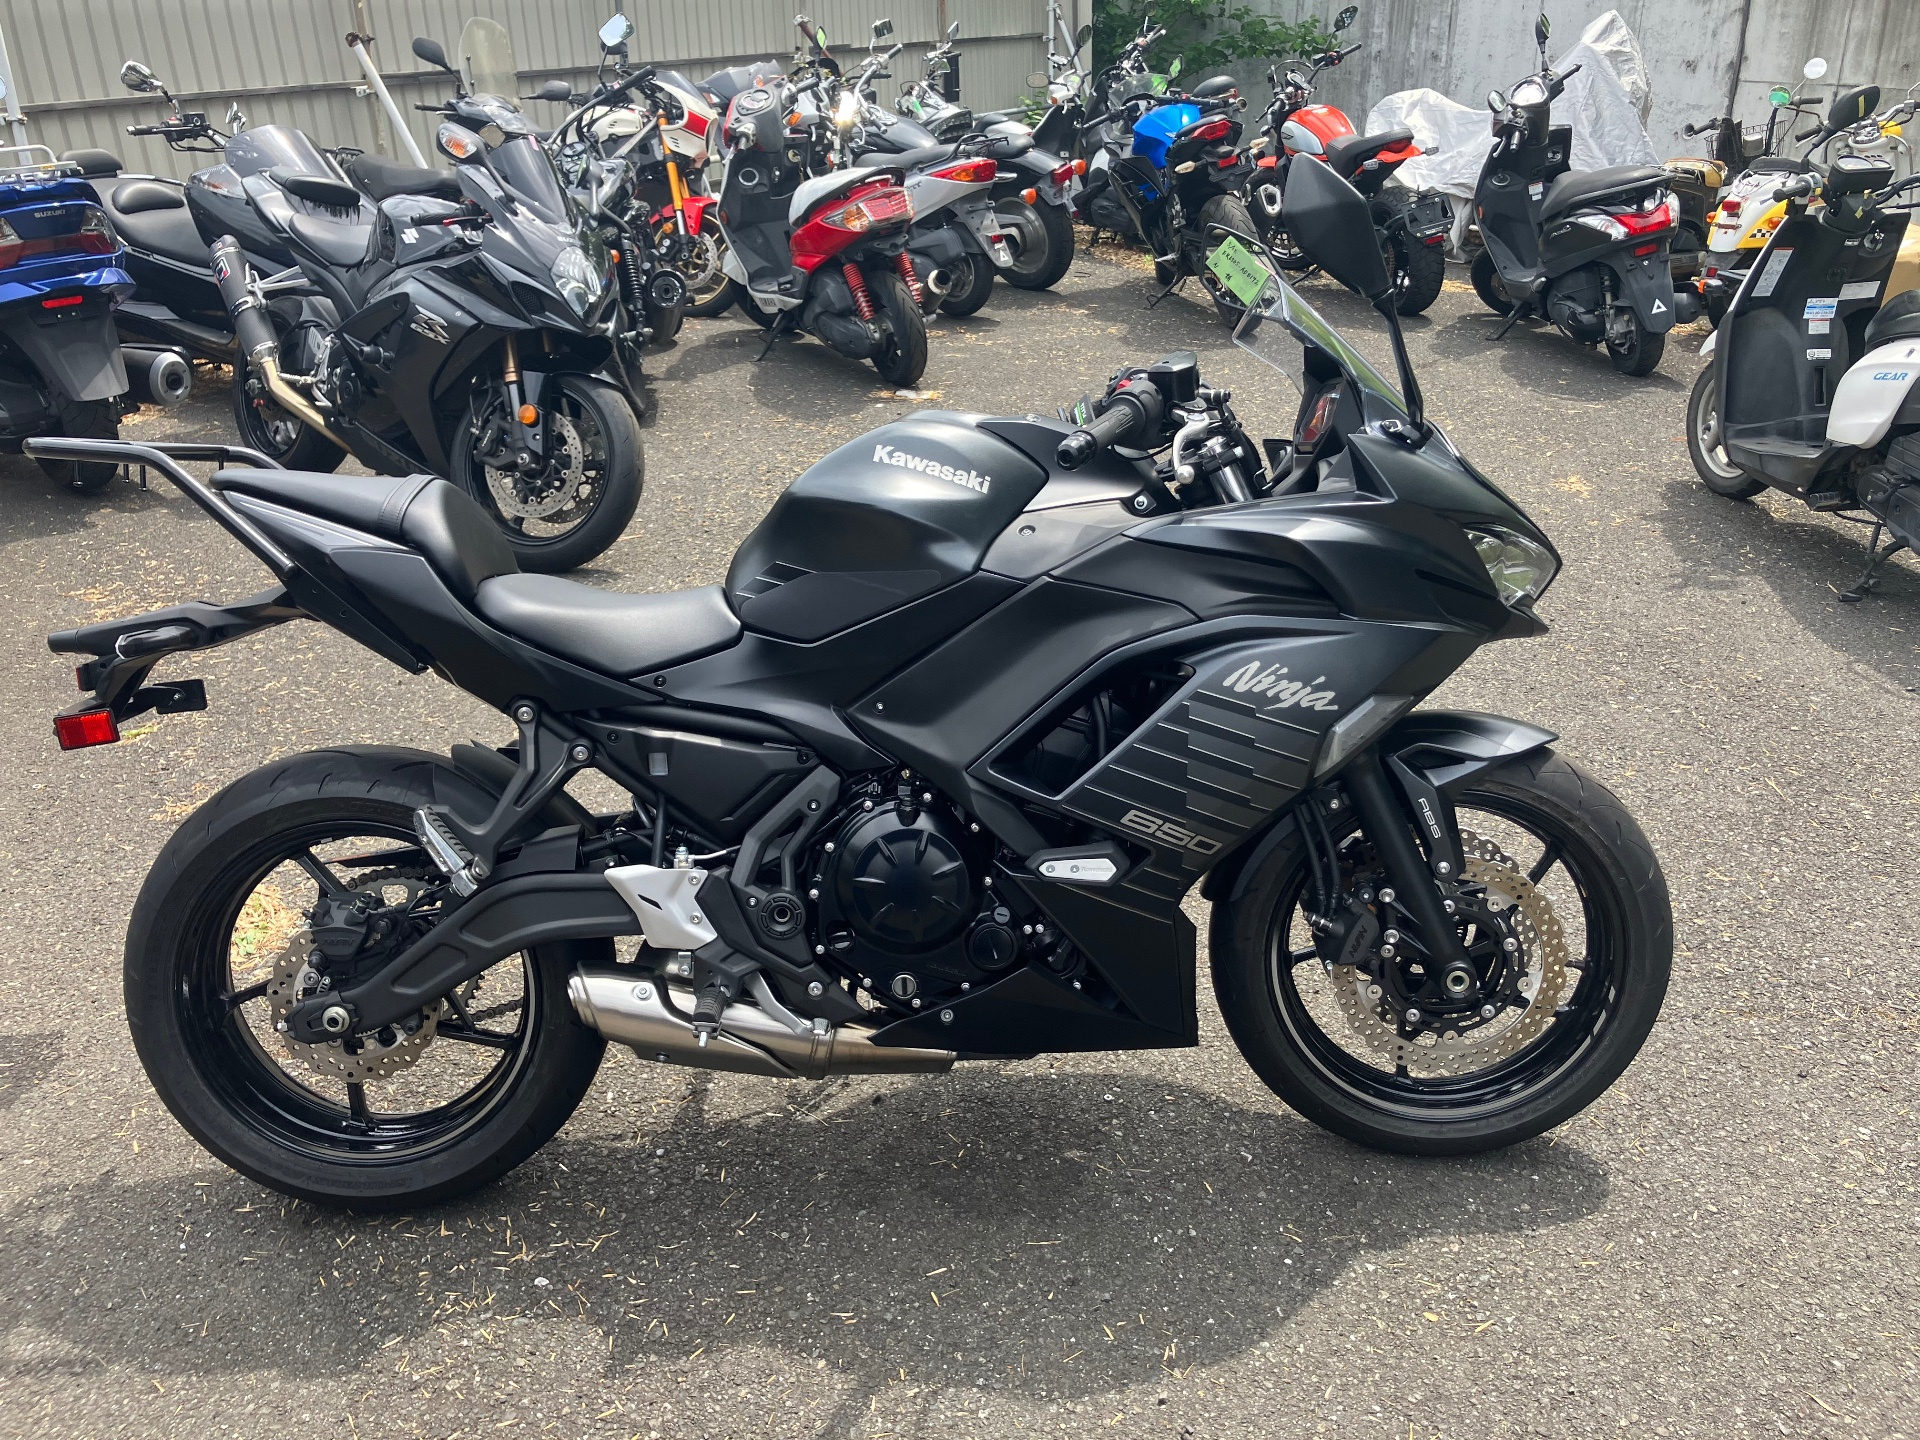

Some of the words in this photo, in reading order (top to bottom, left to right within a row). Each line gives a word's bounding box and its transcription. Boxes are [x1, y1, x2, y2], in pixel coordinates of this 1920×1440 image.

[34, 210, 66, 218] SUZUKI
[1873, 372, 1909, 381] GEAR
[872, 444, 991, 494] Kawasaki
[1222, 660, 1339, 711] Ninja
[1119, 809, 1223, 855] 650
[1417, 797, 1442, 839] ABS
